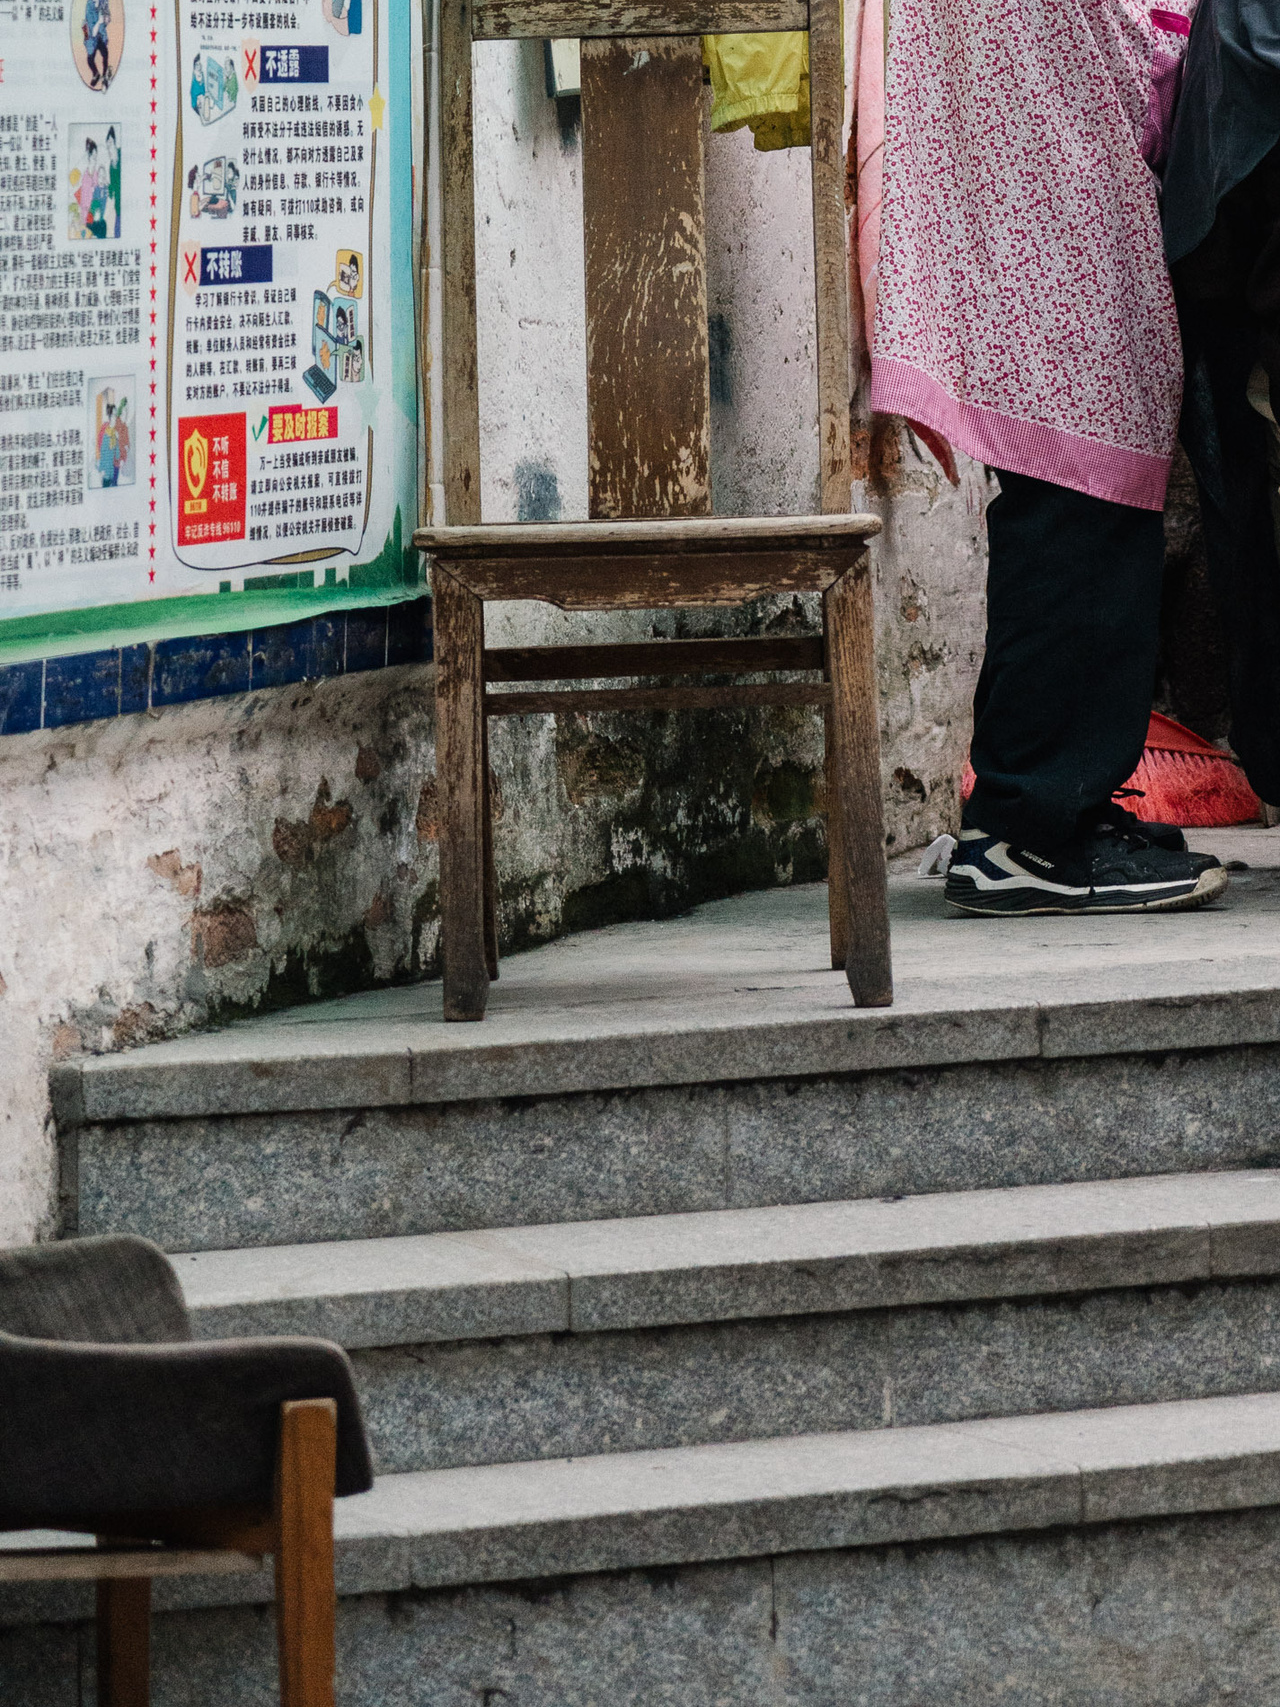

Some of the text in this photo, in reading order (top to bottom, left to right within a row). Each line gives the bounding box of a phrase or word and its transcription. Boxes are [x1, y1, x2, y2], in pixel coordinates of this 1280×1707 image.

[266, 49, 300, 78] 不透露
[206, 250, 242, 280] 不转账
[272, 409, 329, 443] 要及时报案
[212, 436, 230, 456] 不听
[212, 460, 230, 480] 不信
[212, 482, 238, 505] 不转账
